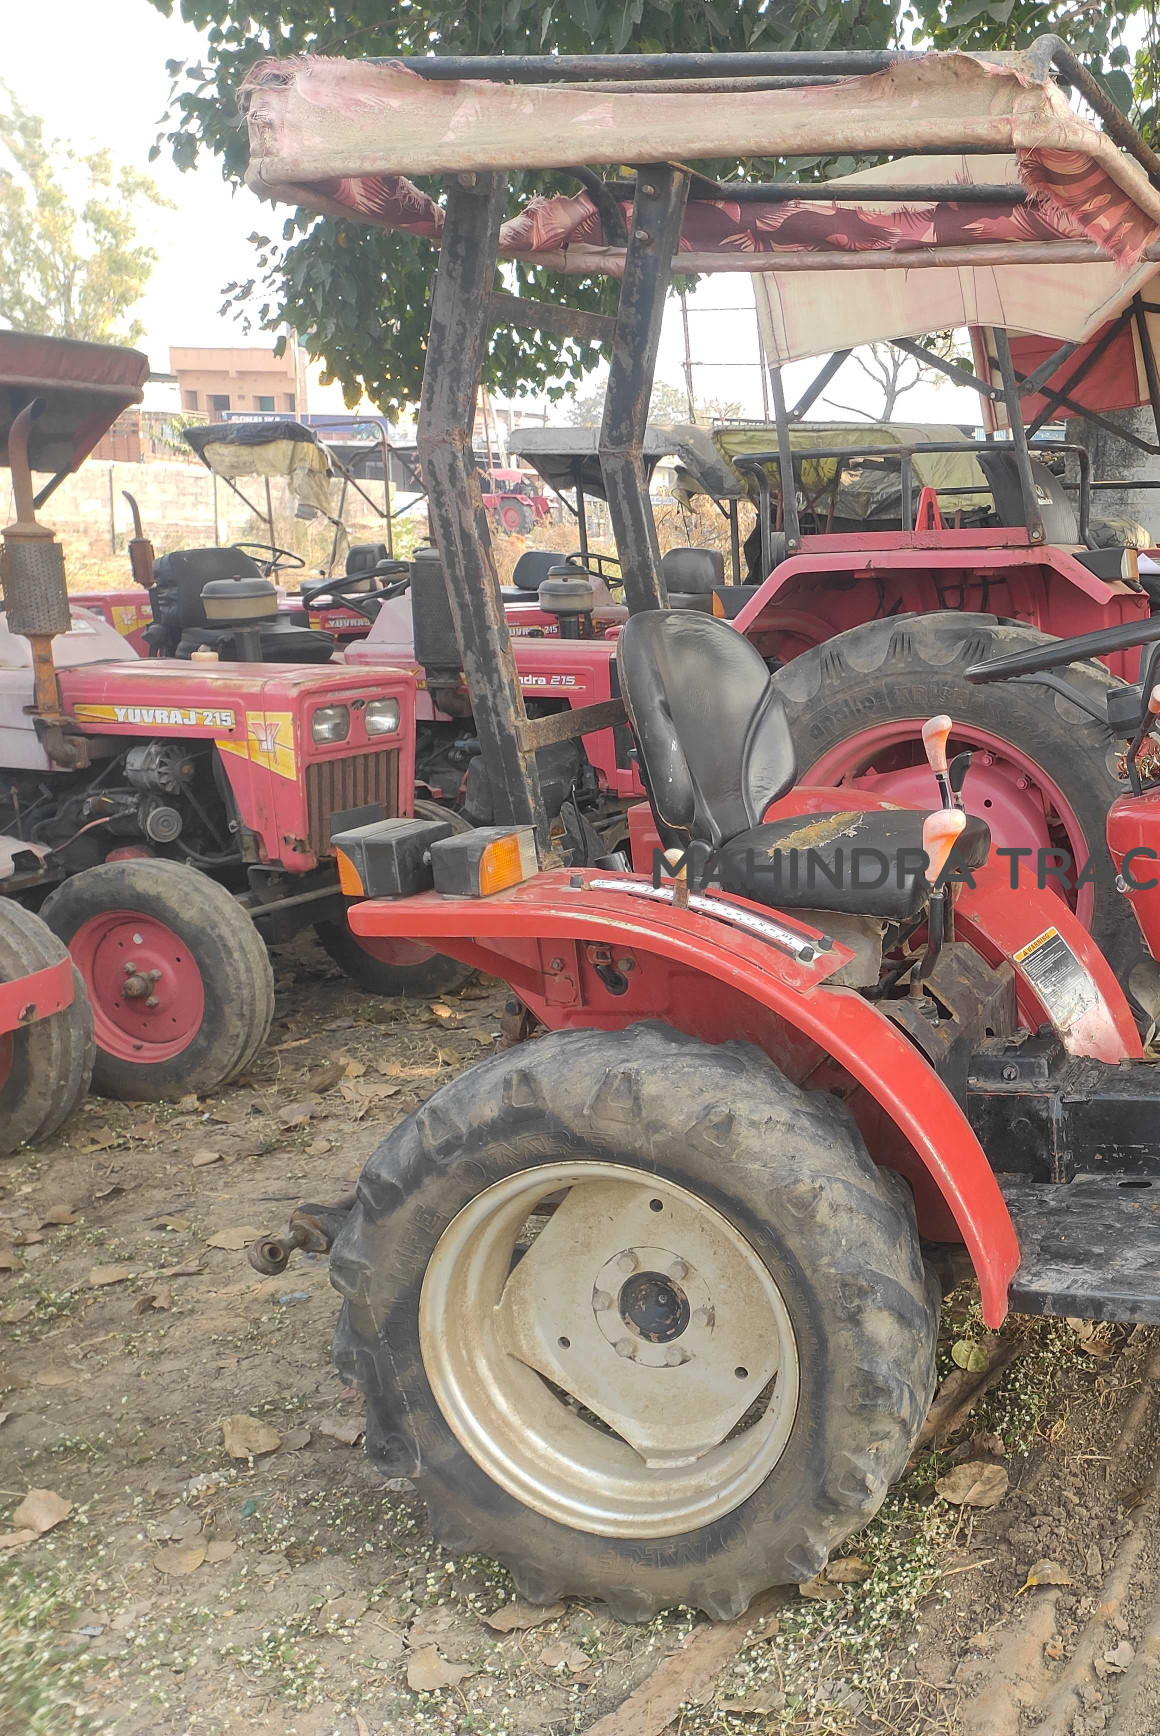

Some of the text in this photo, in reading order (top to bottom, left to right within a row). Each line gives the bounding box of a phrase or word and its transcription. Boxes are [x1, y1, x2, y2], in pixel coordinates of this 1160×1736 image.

[550, 675, 576, 685] 215
[113, 707, 233, 726] YUVRAJ 215
[1027, 933, 1050, 953] WARNING
[486, 1129, 615, 1169] MRF
